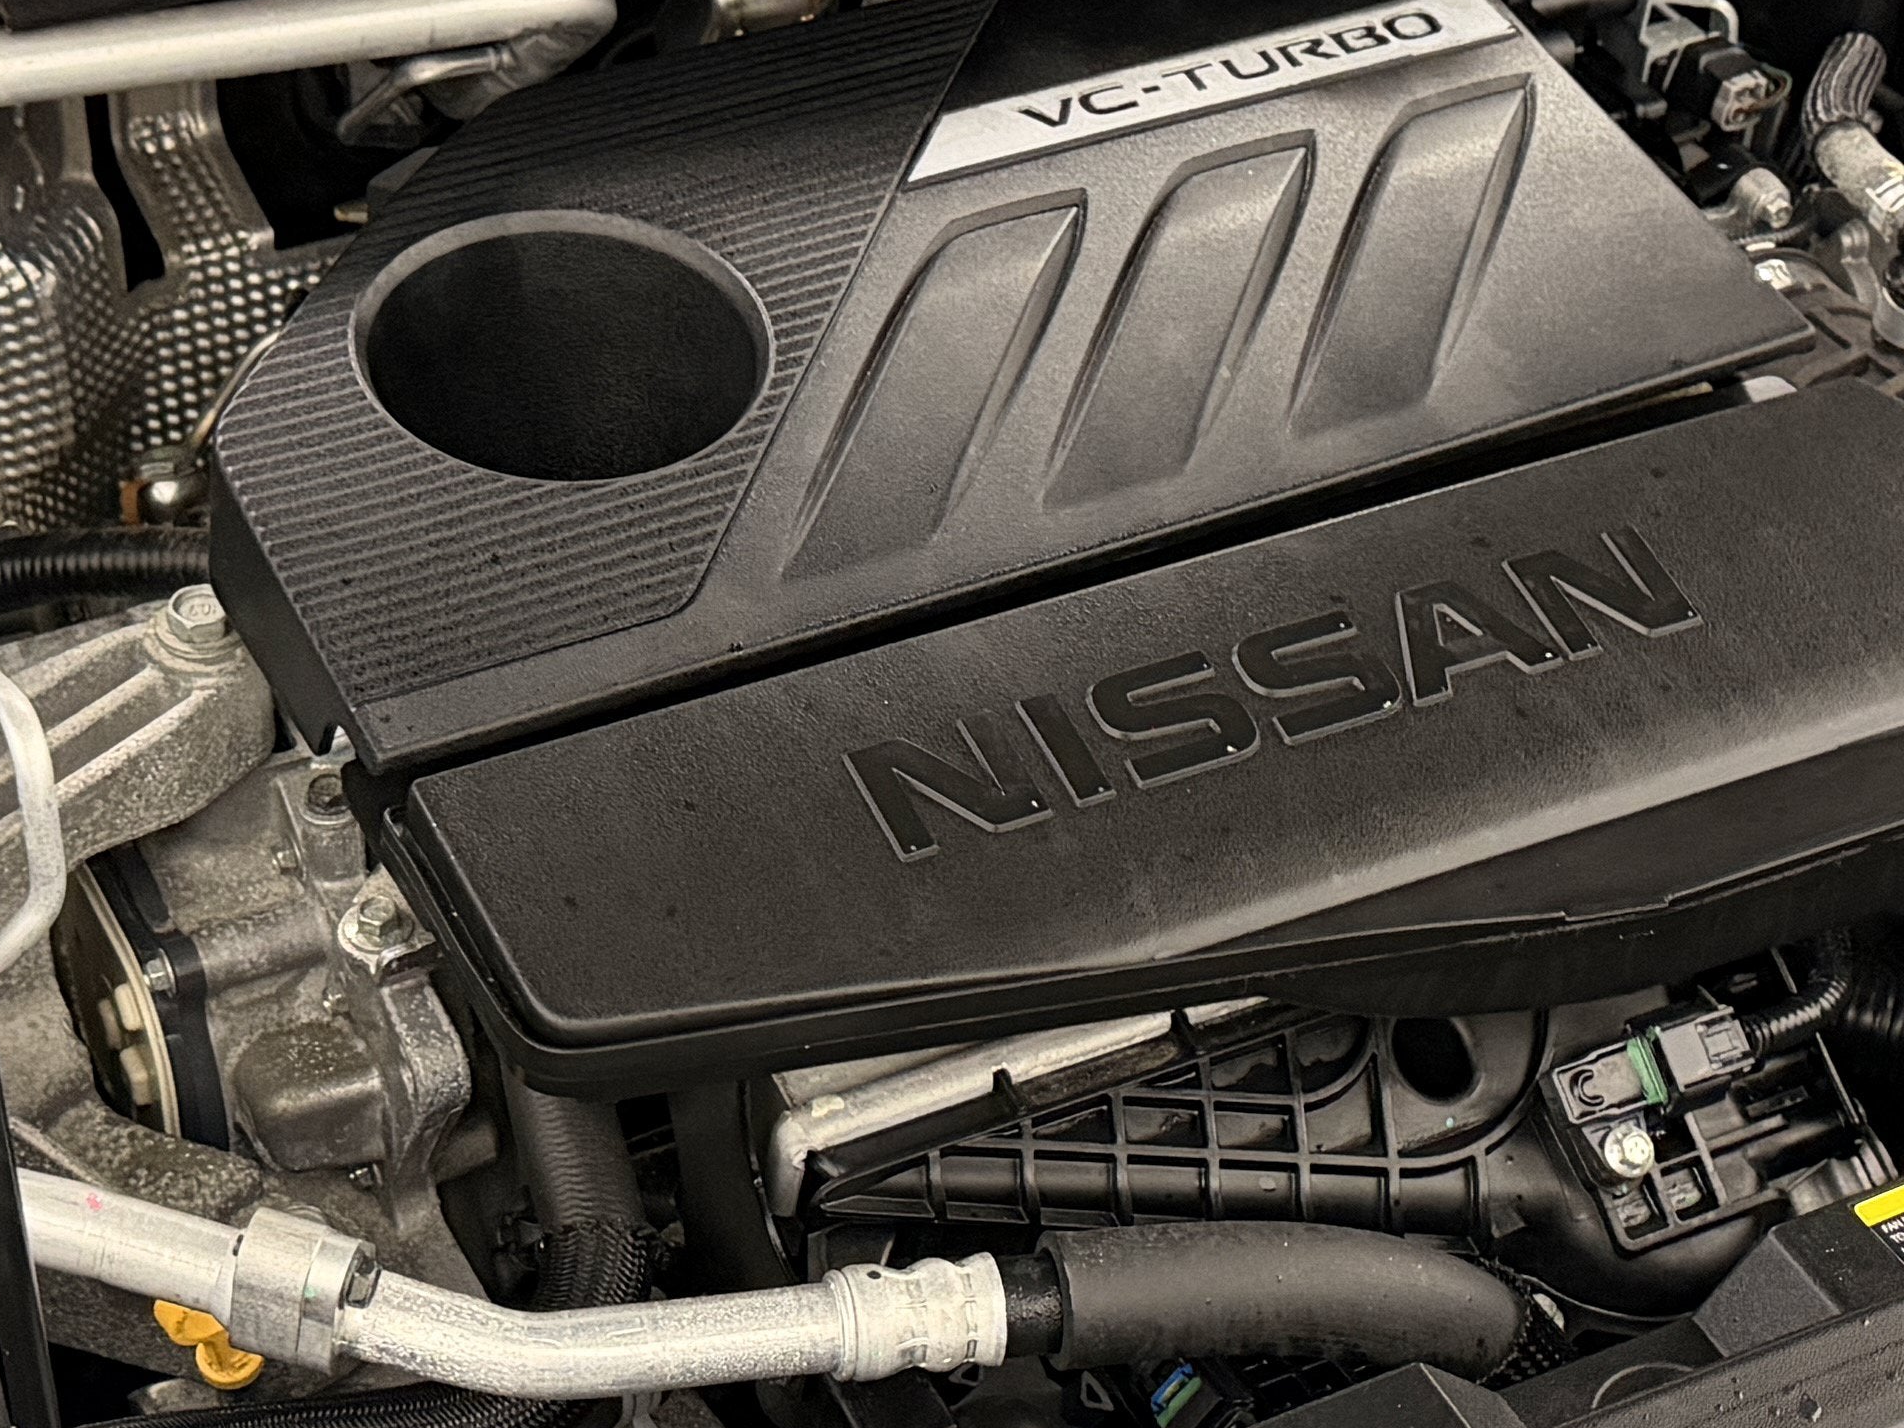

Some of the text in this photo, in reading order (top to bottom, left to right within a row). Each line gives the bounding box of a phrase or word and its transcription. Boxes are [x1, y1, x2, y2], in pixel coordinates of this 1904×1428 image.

[1018, 12, 1442, 129] VC-TURBO
[842, 526, 1702, 862] NISSAN
[1880, 1216, 1903, 1234] FAN
